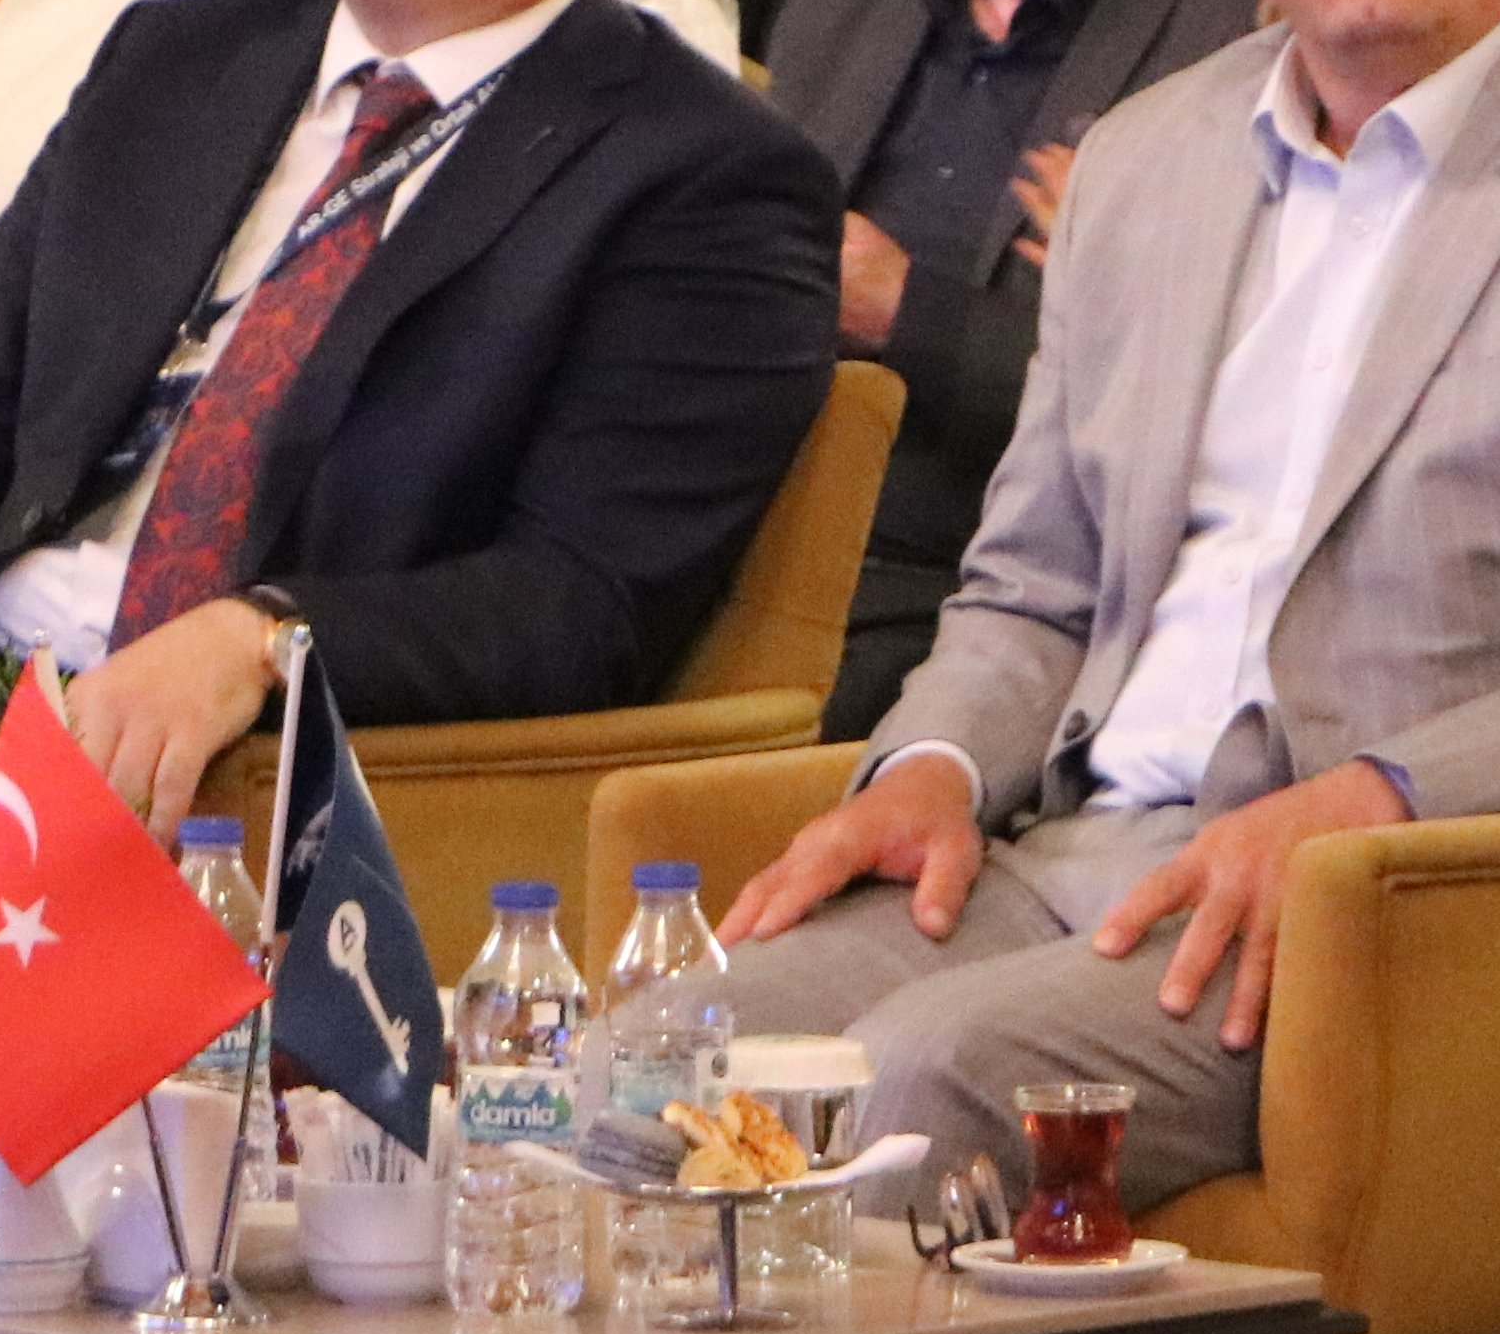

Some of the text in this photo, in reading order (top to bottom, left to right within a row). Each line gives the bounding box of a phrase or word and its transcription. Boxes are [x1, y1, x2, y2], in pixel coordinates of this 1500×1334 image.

[297, 187, 352, 240] AR-GE
[408, 132, 432, 154] ve
[470, 1098, 557, 1127] damla
